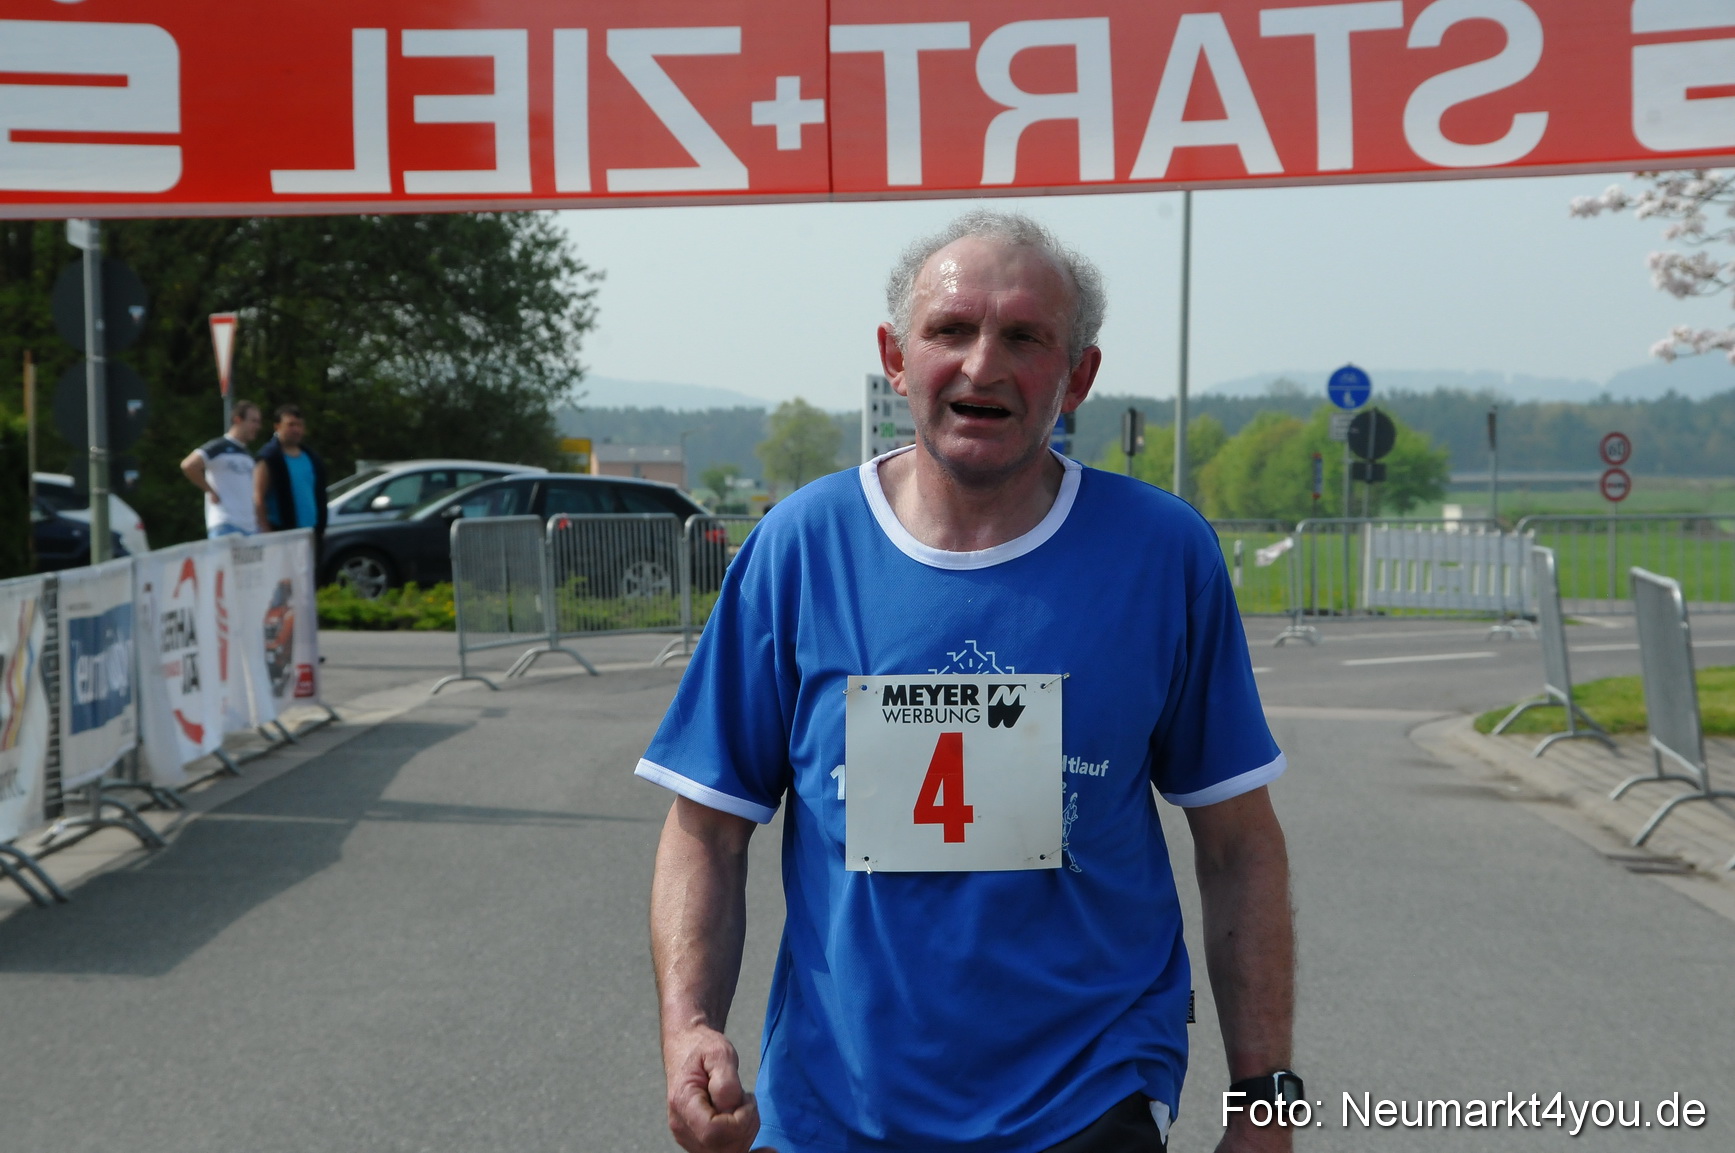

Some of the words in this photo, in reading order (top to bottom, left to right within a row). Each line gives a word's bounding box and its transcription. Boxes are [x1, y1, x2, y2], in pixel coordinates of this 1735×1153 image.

[882, 684, 980, 706] MEYER
[882, 707, 981, 724] WERBUNG
[913, 731, 974, 843] 4
